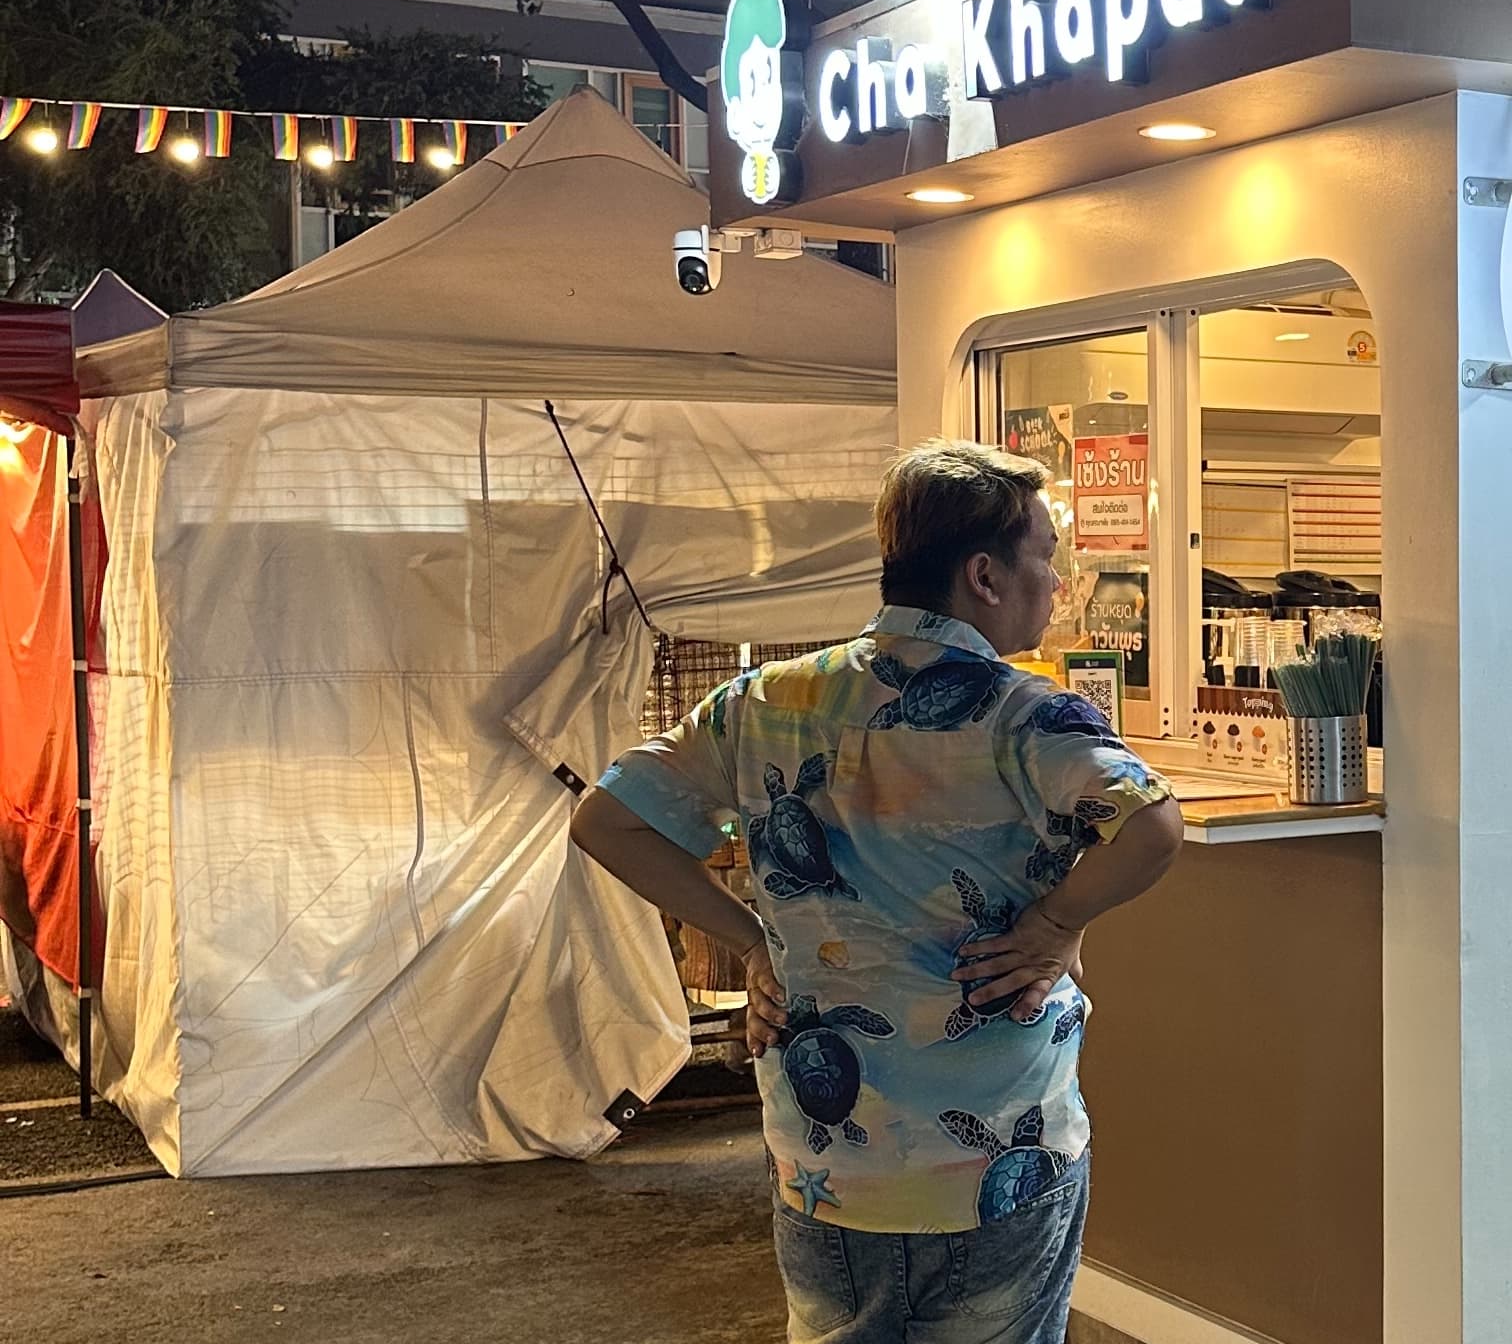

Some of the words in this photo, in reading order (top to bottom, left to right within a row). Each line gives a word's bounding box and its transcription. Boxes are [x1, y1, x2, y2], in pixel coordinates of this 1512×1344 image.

[820, 40, 926, 143] Cha
[1077, 448, 1146, 488] เซ้งร้าน
[1090, 596, 1132, 625] ร้านหยุด
